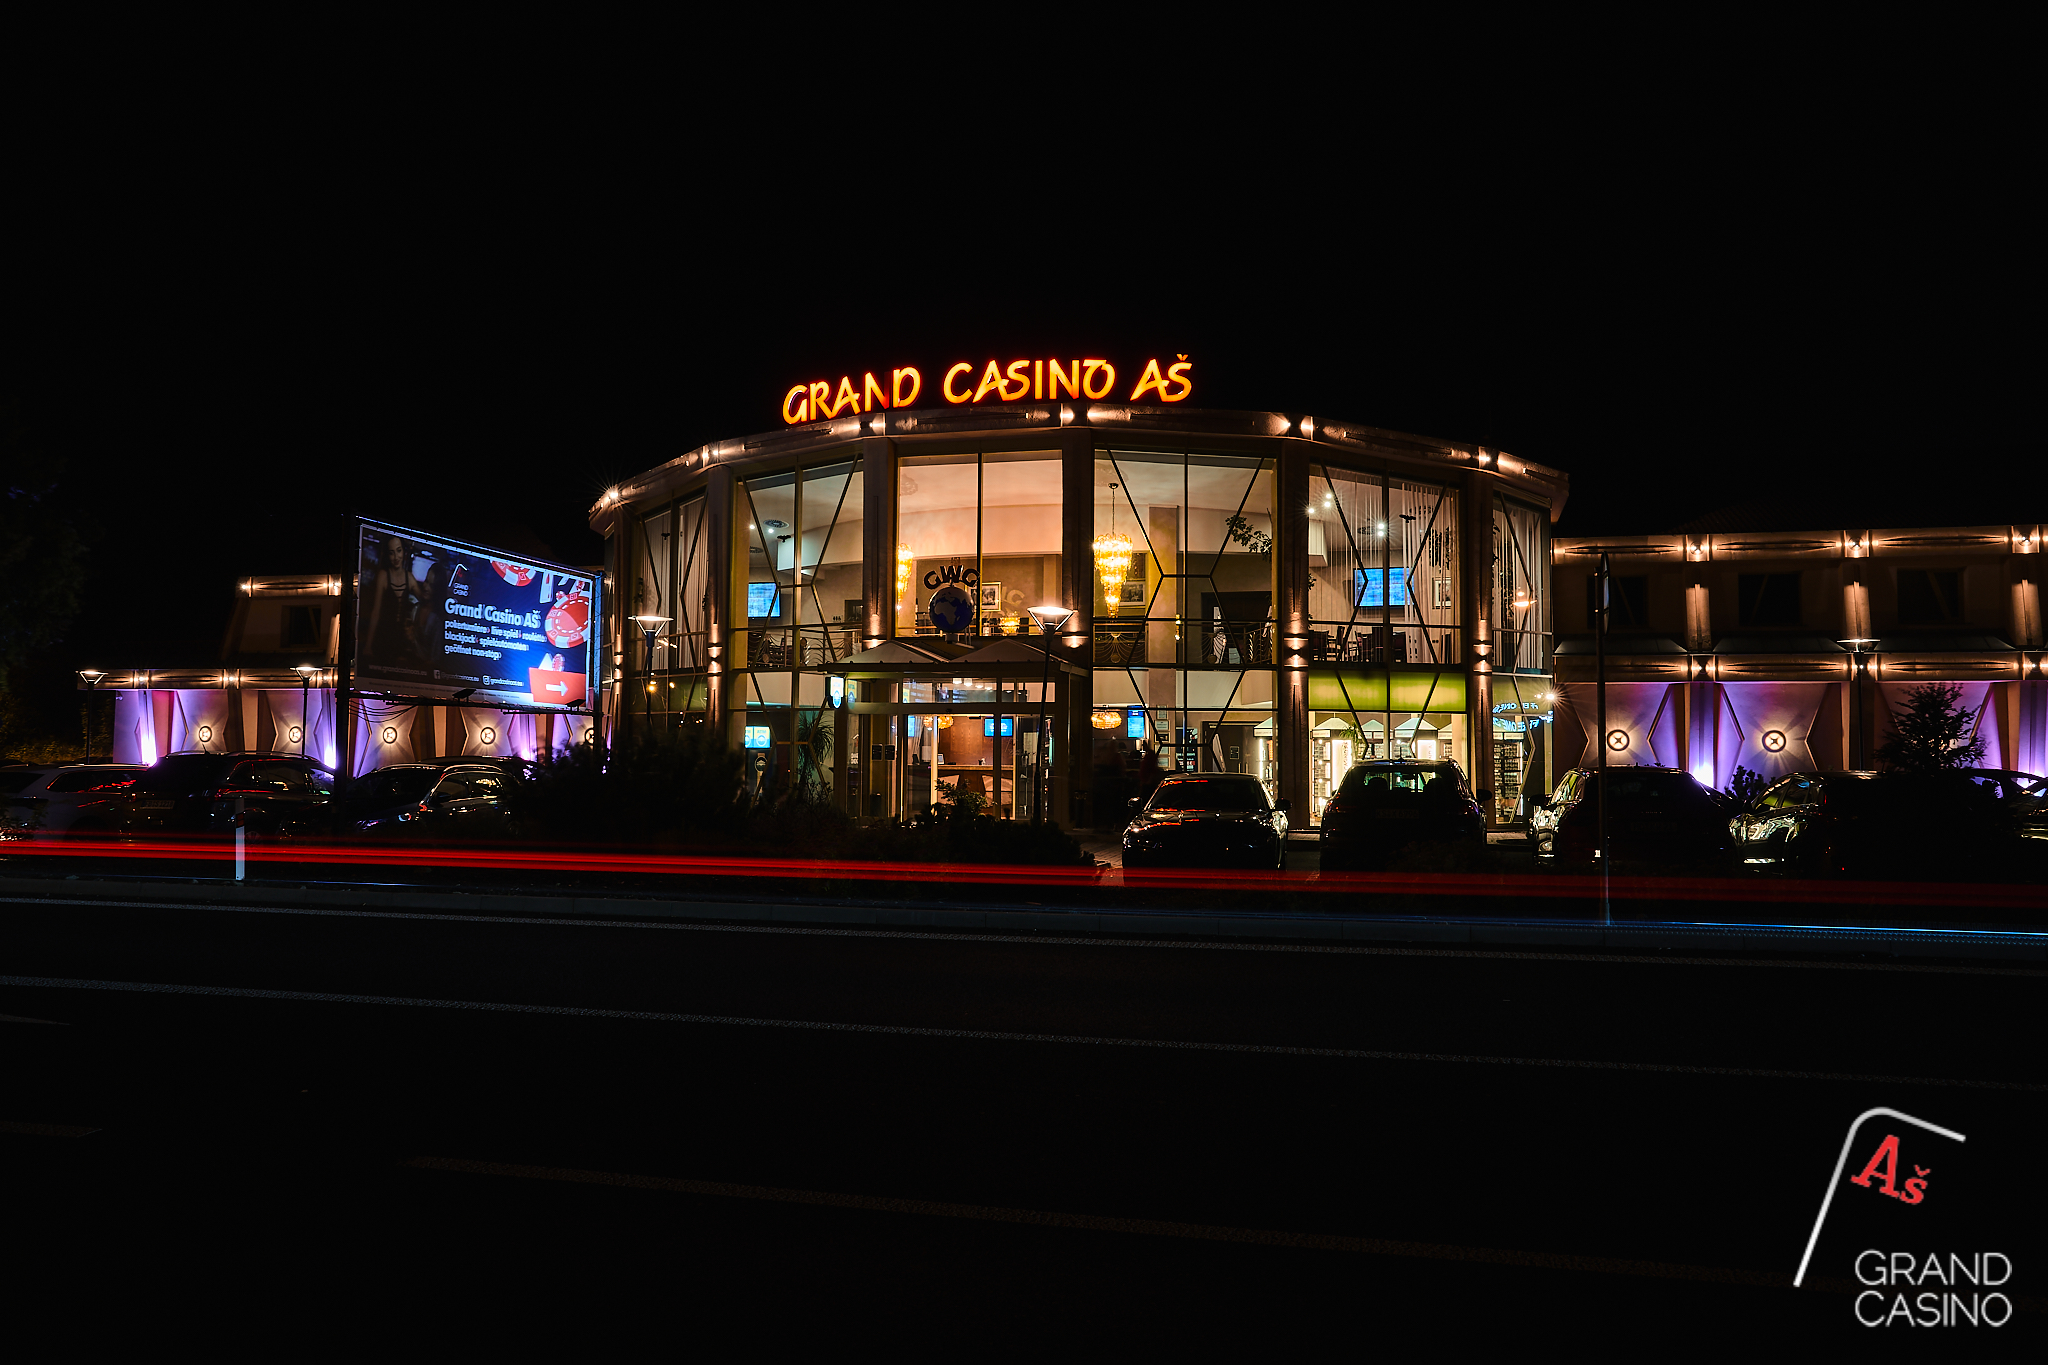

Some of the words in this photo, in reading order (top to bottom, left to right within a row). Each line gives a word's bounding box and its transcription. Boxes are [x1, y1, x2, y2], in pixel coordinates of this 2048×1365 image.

[782, 366, 922, 424] GRAND
[943, 358, 1115, 404] CASINO
[1130, 354, 1193, 403] AŠ
[923, 564, 981, 590] GWG
[444, 598, 484, 620] Grand
[484, 605, 524, 626] Casino
[523, 609, 541, 629] AŠ
